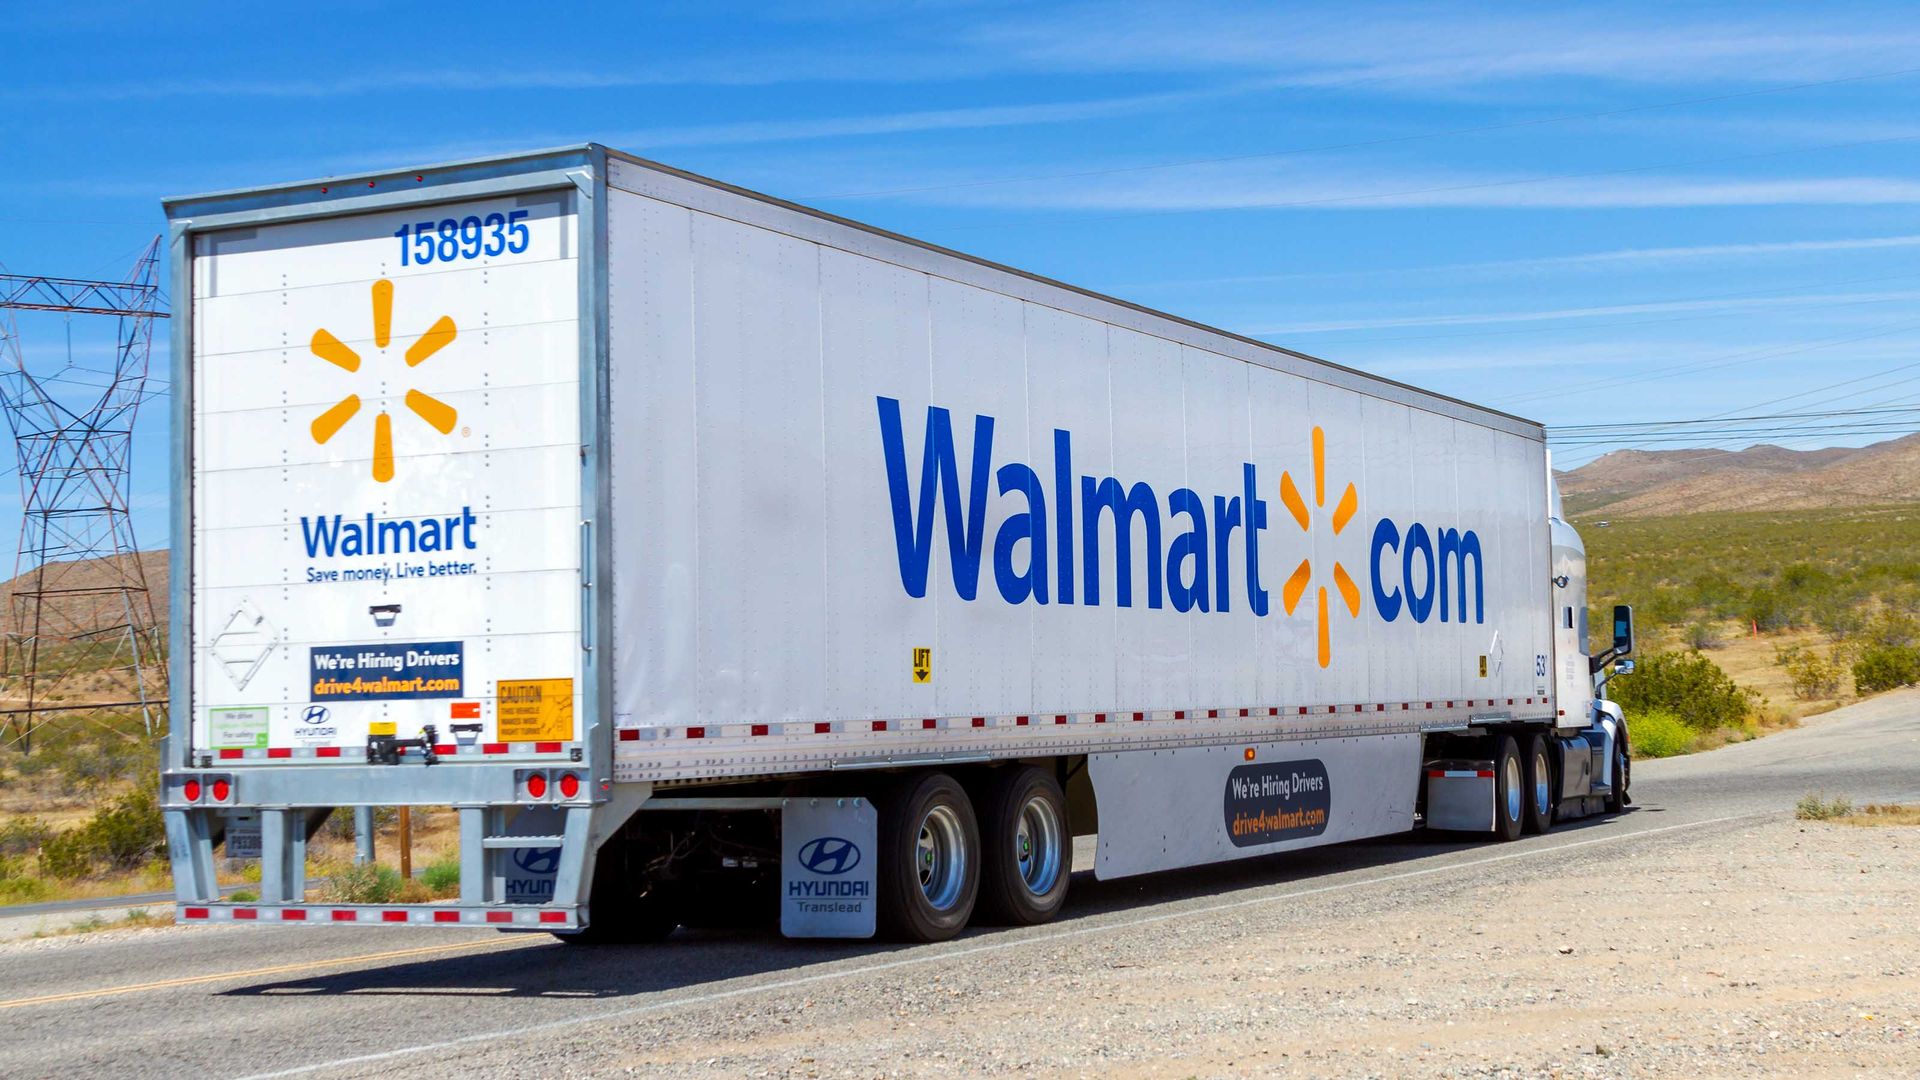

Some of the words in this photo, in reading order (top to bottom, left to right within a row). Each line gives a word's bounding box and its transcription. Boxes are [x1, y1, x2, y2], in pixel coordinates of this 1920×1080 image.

[395, 210, 529, 266] 158935
[876, 395, 1269, 617] Walmart
[301, 506, 477, 558] Walmart
[307, 567, 338, 582] Save
[343, 567, 393, 585] money.
[397, 561, 425, 578] Live
[429, 561, 477, 576] better.
[314, 654, 355, 669] We're
[358, 652, 403, 672] Hiring
[406, 650, 460, 667] Drivers
[913, 648, 930, 667] LIFT
[314, 676, 460, 695] drive4walmart.com
[501, 685, 542, 704] CAUTION
[1232, 777, 1260, 800] We're
[1262, 774, 1290, 800] Hiring
[1292, 771, 1323, 793] Drivers
[1233, 807, 1325, 836] drive4walmart.com
[788, 881, 869, 896] HYUNDAI
[797, 902, 862, 913] Translead
